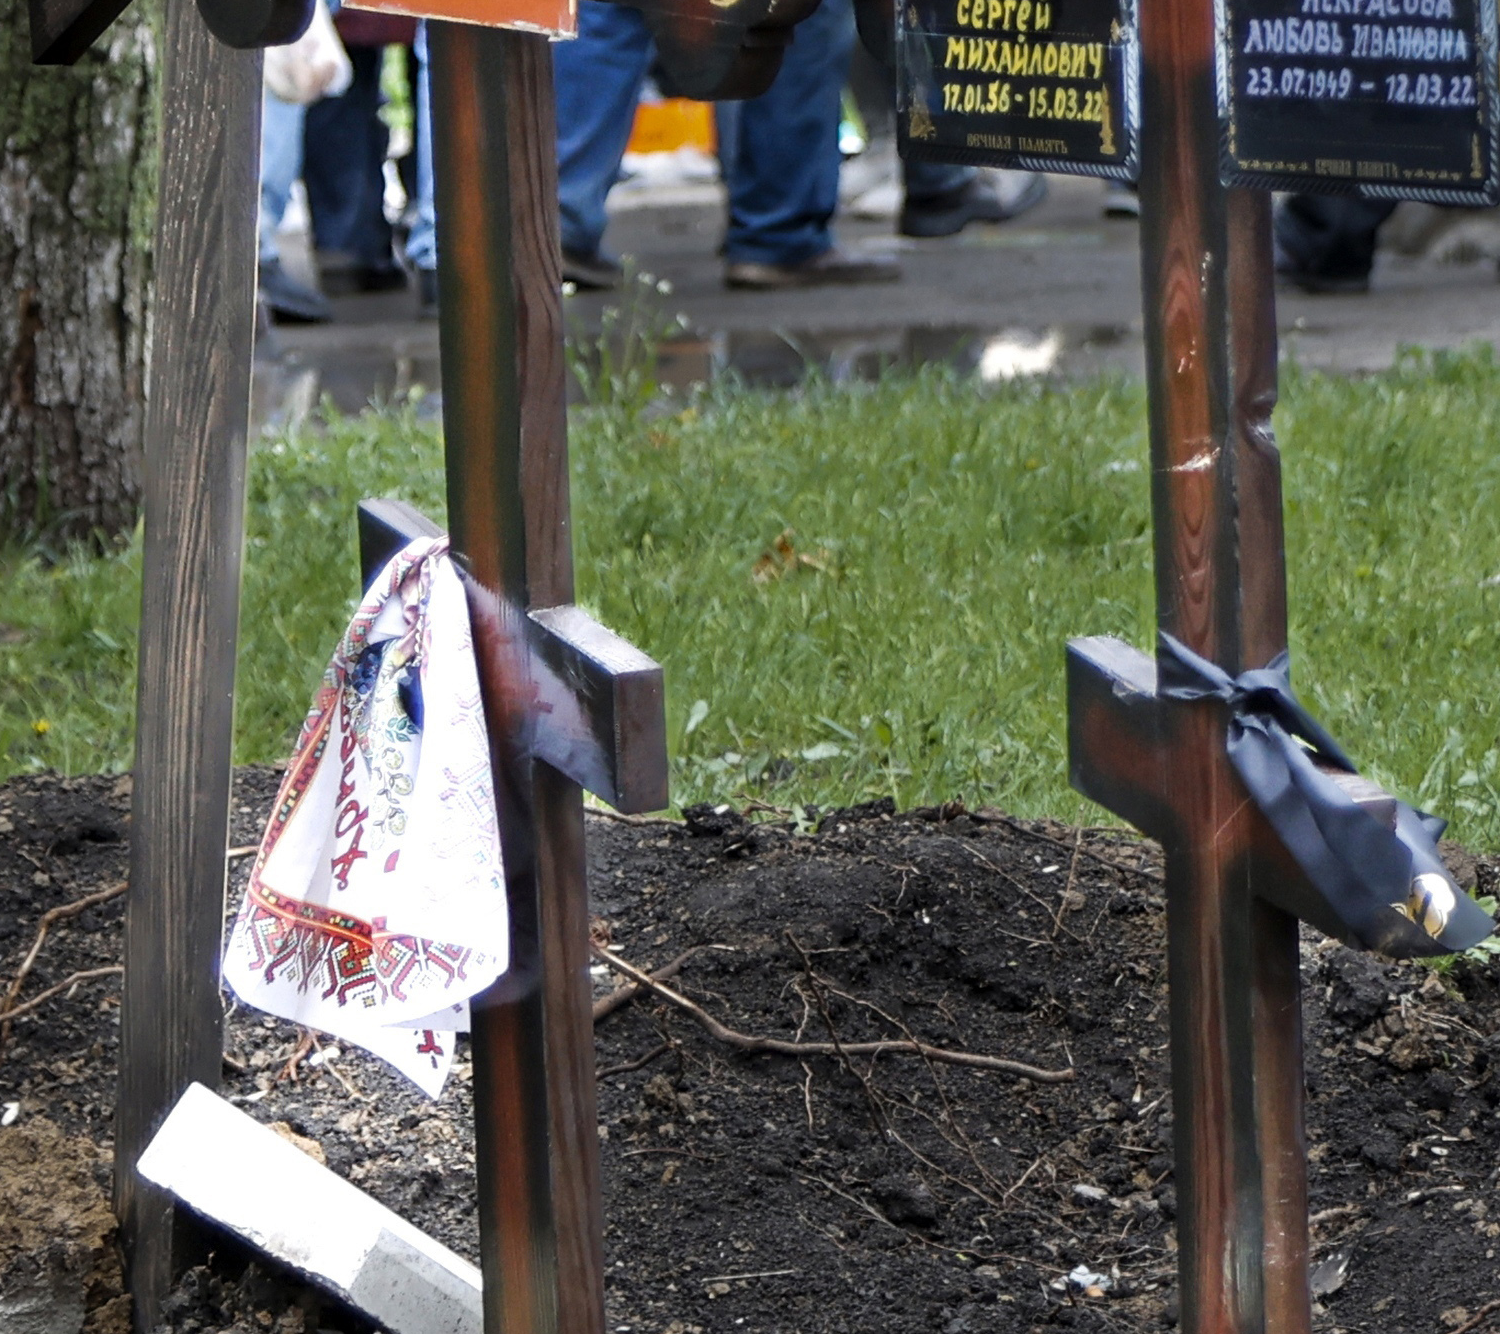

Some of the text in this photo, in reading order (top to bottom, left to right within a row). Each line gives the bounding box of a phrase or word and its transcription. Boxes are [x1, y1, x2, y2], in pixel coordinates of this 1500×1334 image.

[944, 34, 1103, 79] МИХАЙЛОВИЧ
[1244, 17, 1468, 62] ЛЮБОВЬ ИВАНОВНА
[1018, 136, 1068, 154] ПАМЯТЬ
